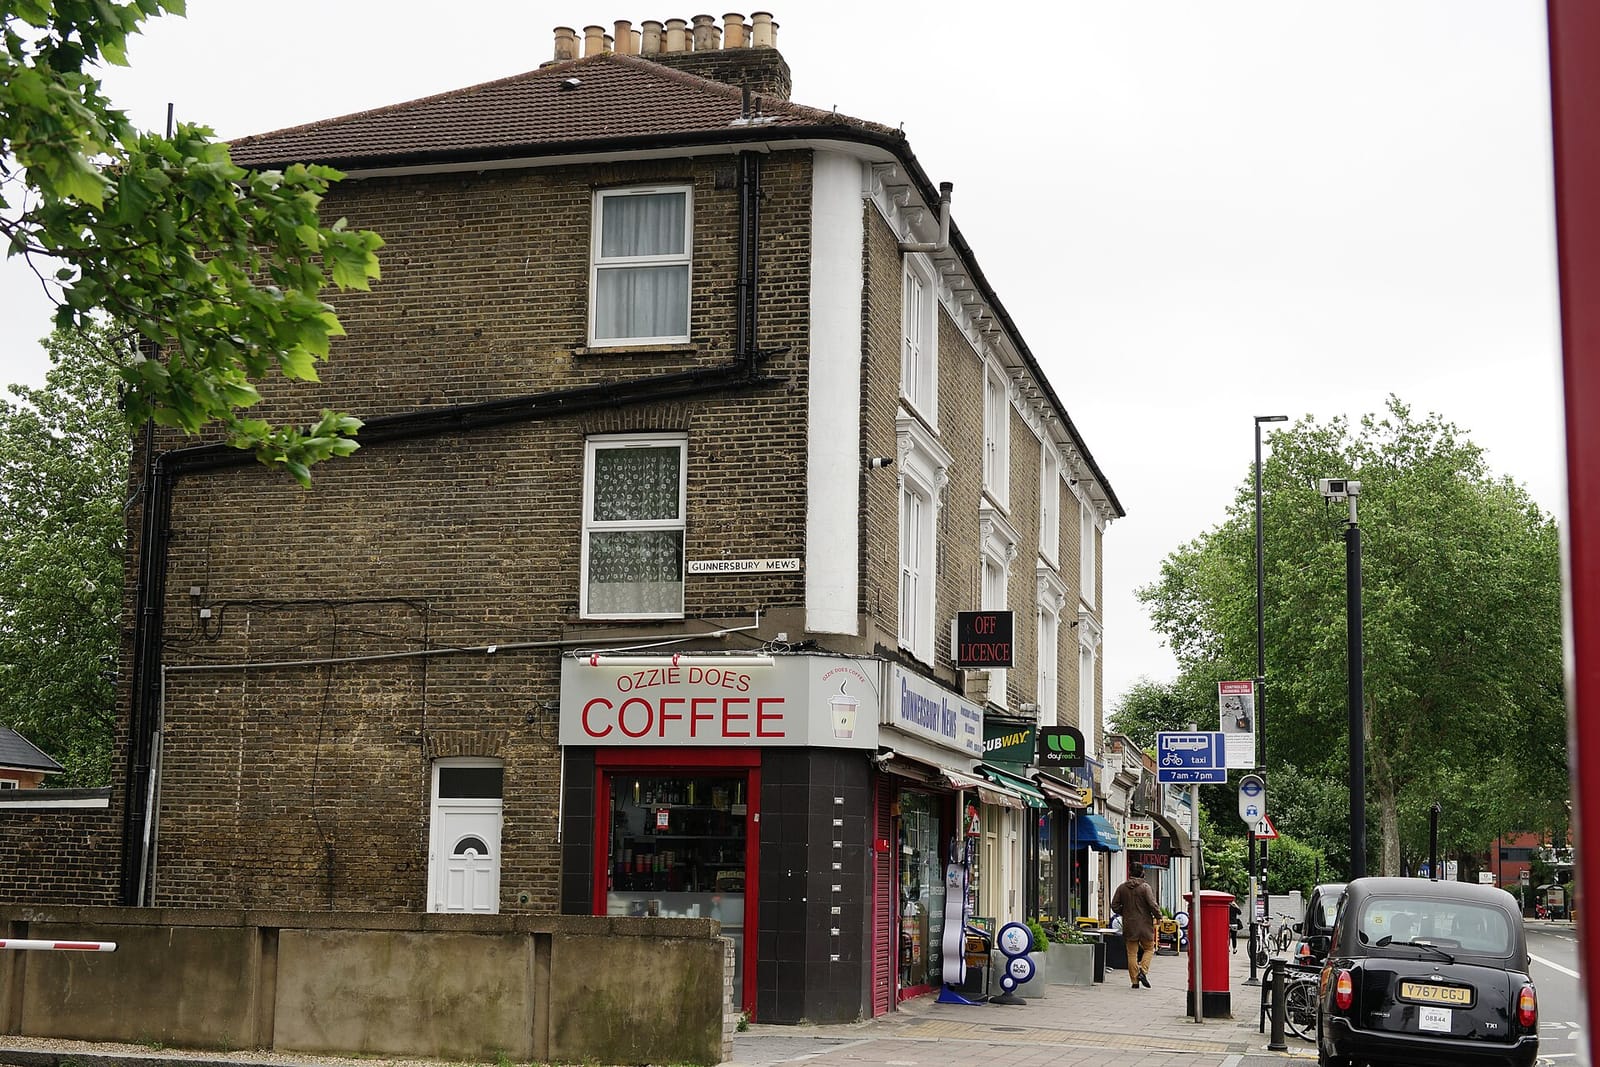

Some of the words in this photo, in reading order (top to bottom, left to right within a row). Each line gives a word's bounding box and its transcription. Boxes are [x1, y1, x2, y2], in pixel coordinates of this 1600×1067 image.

[691, 560, 760, 571] GUNNERSBURY
[766, 560, 796, 570] MEWS
[974, 615, 997, 634] OFF
[960, 643, 1010, 662] LICENCE
[616, 667, 681, 693] OZZIE
[688, 667, 751, 692] DOES
[901, 676, 940, 733] GUNNERSBURY
[581, 697, 786, 738] COFFEE
[982, 730, 1030, 753] SUBWAY
[1191, 756, 1207, 764] taxi
[1140, 853, 1169, 866] LICENCE
[1407, 985, 1438, 998] Y767
[1441, 989, 1465, 1001] CGJ
